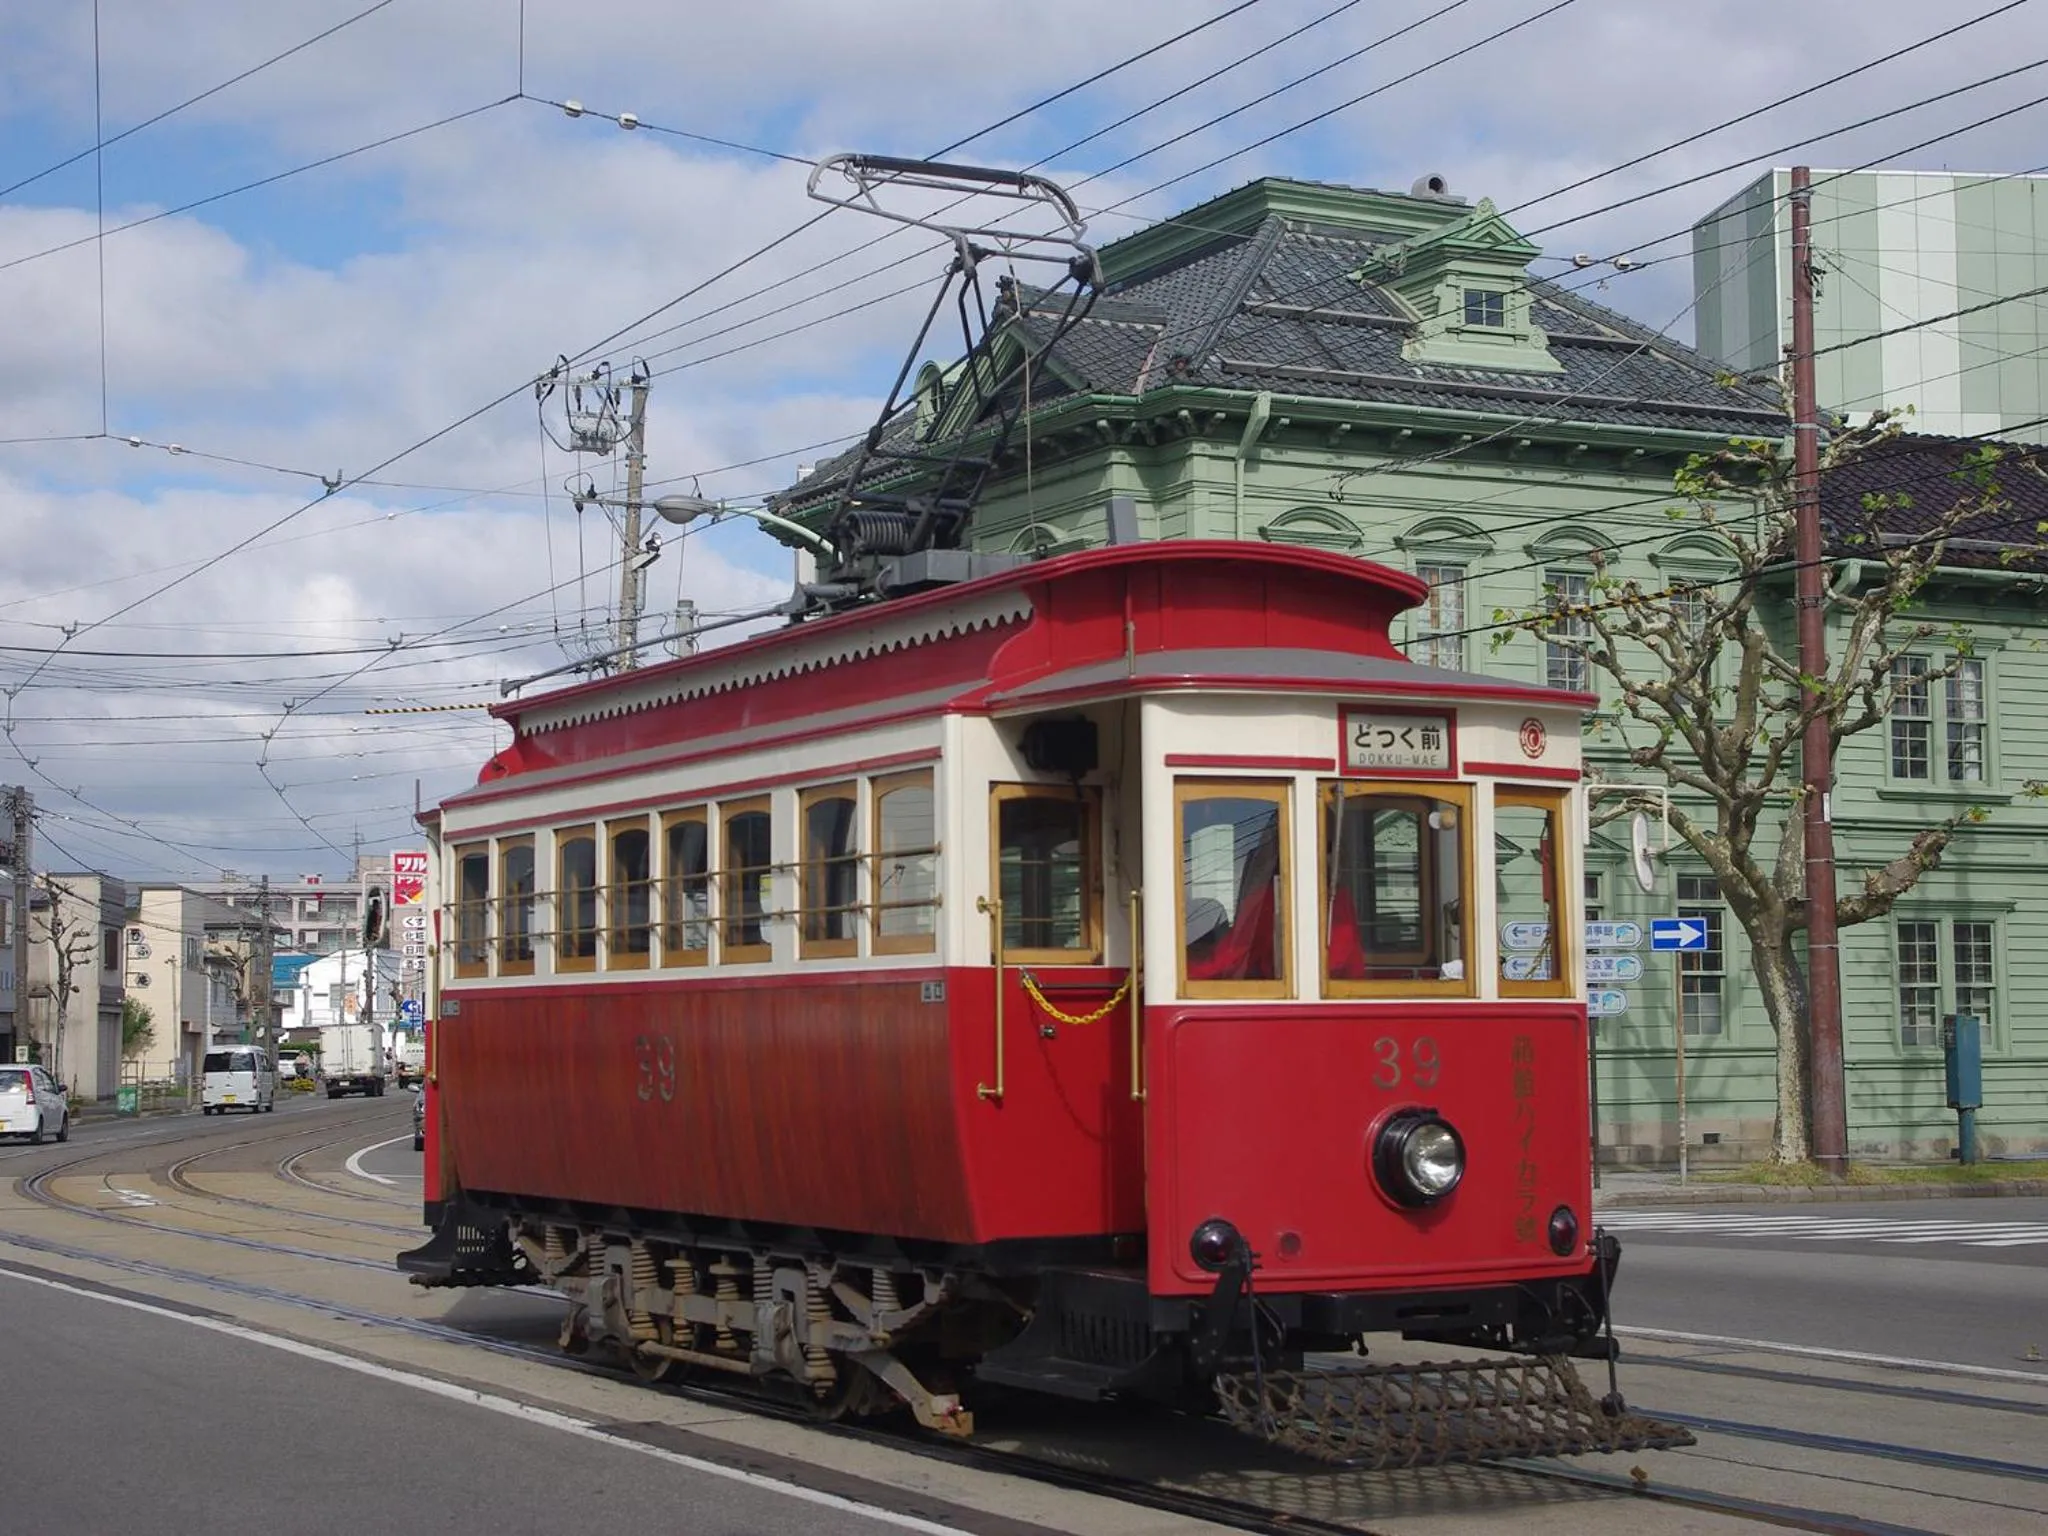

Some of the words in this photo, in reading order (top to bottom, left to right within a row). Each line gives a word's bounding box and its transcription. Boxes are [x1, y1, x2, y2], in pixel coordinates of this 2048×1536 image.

[1355, 724, 1440, 750] どつく前
[1359, 753, 1437, 766] DOKKU-MAE
[636, 1034, 676, 1102] 39
[1373, 1036, 1441, 1090] 39
